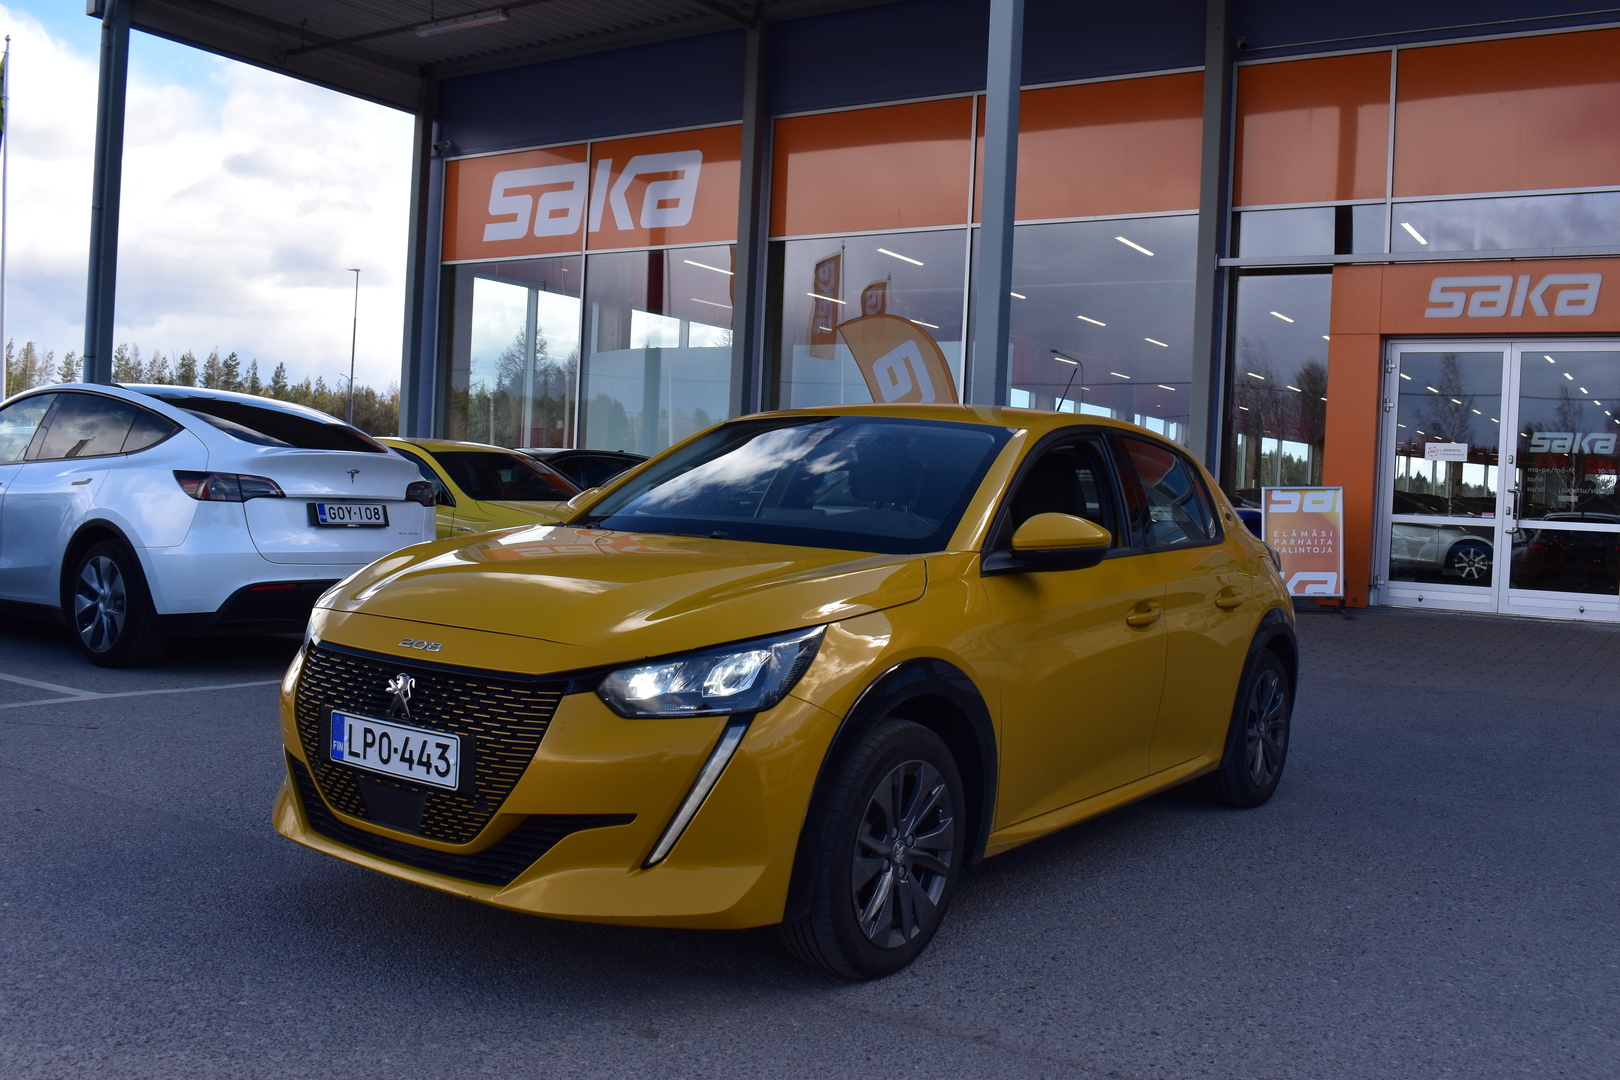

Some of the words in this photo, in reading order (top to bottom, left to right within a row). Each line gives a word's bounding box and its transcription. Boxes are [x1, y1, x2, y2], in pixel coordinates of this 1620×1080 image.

[1273, 529, 1333, 537] ELÄMÄSI
[398, 637, 443, 652] 208
[332, 740, 344, 752] FIN
[348, 723, 451, 778] LPO-443
